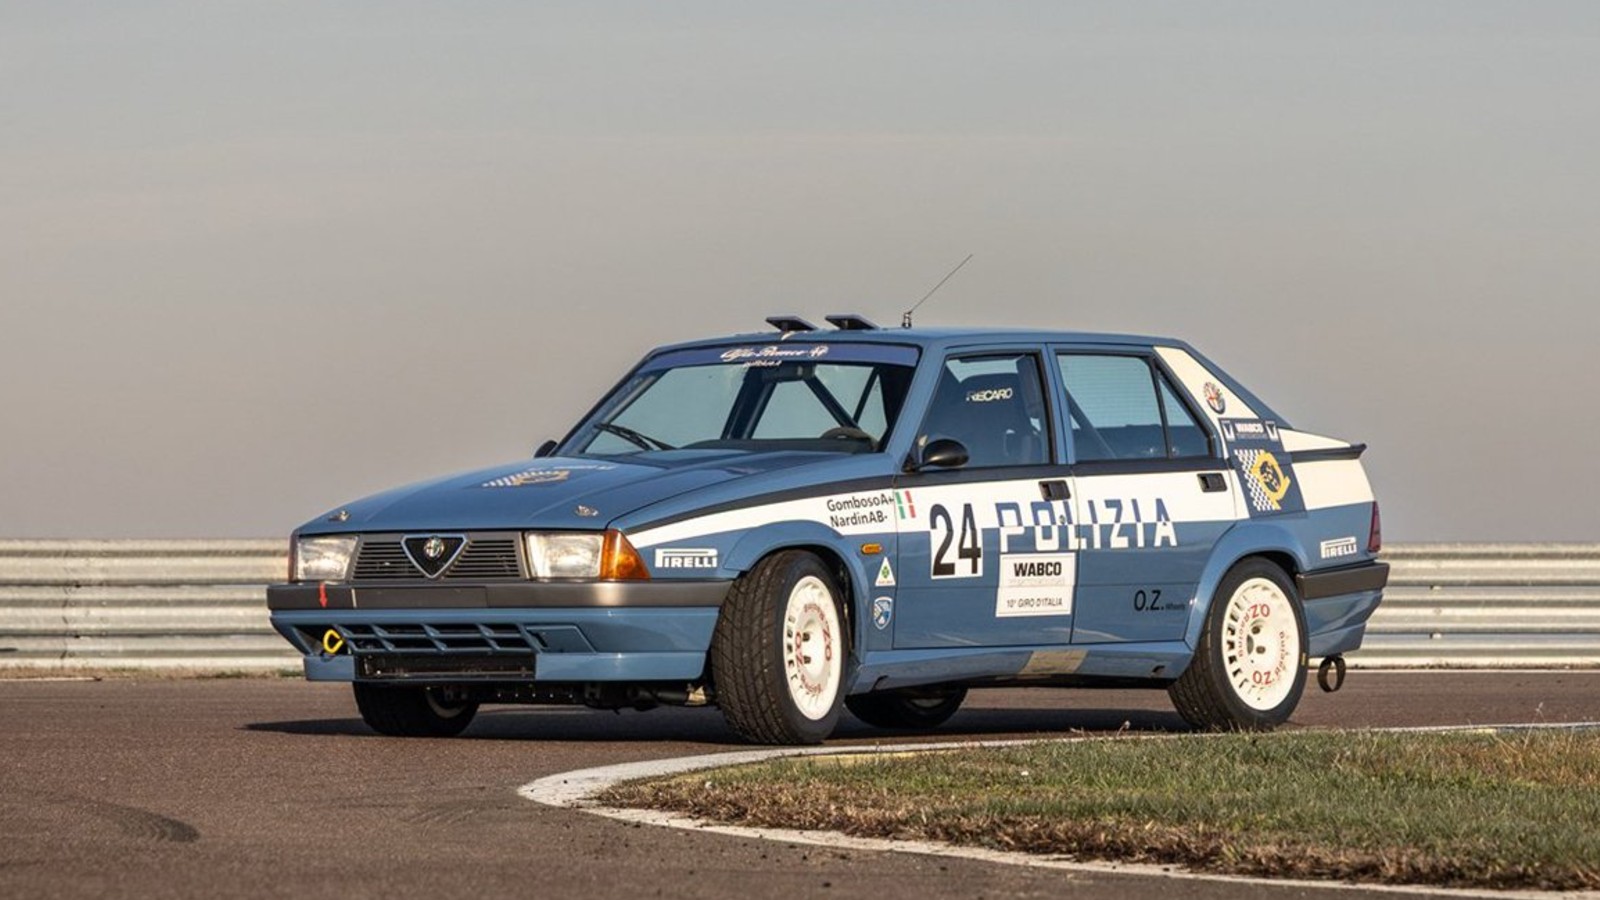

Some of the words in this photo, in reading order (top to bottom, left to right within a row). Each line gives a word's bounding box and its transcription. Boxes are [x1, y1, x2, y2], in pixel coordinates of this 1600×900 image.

[965, 387, 1013, 402] RECARO
[995, 498, 1179, 552] POLIZIA
[930, 503, 982, 576] 24
[1320, 536, 1357, 559] PIRELLI
[655, 548, 718, 568] PIRELLI
[1013, 561, 1062, 577] WABCO
[1017, 598, 1035, 608] GIRO
[1134, 589, 1165, 611] O.Z.
